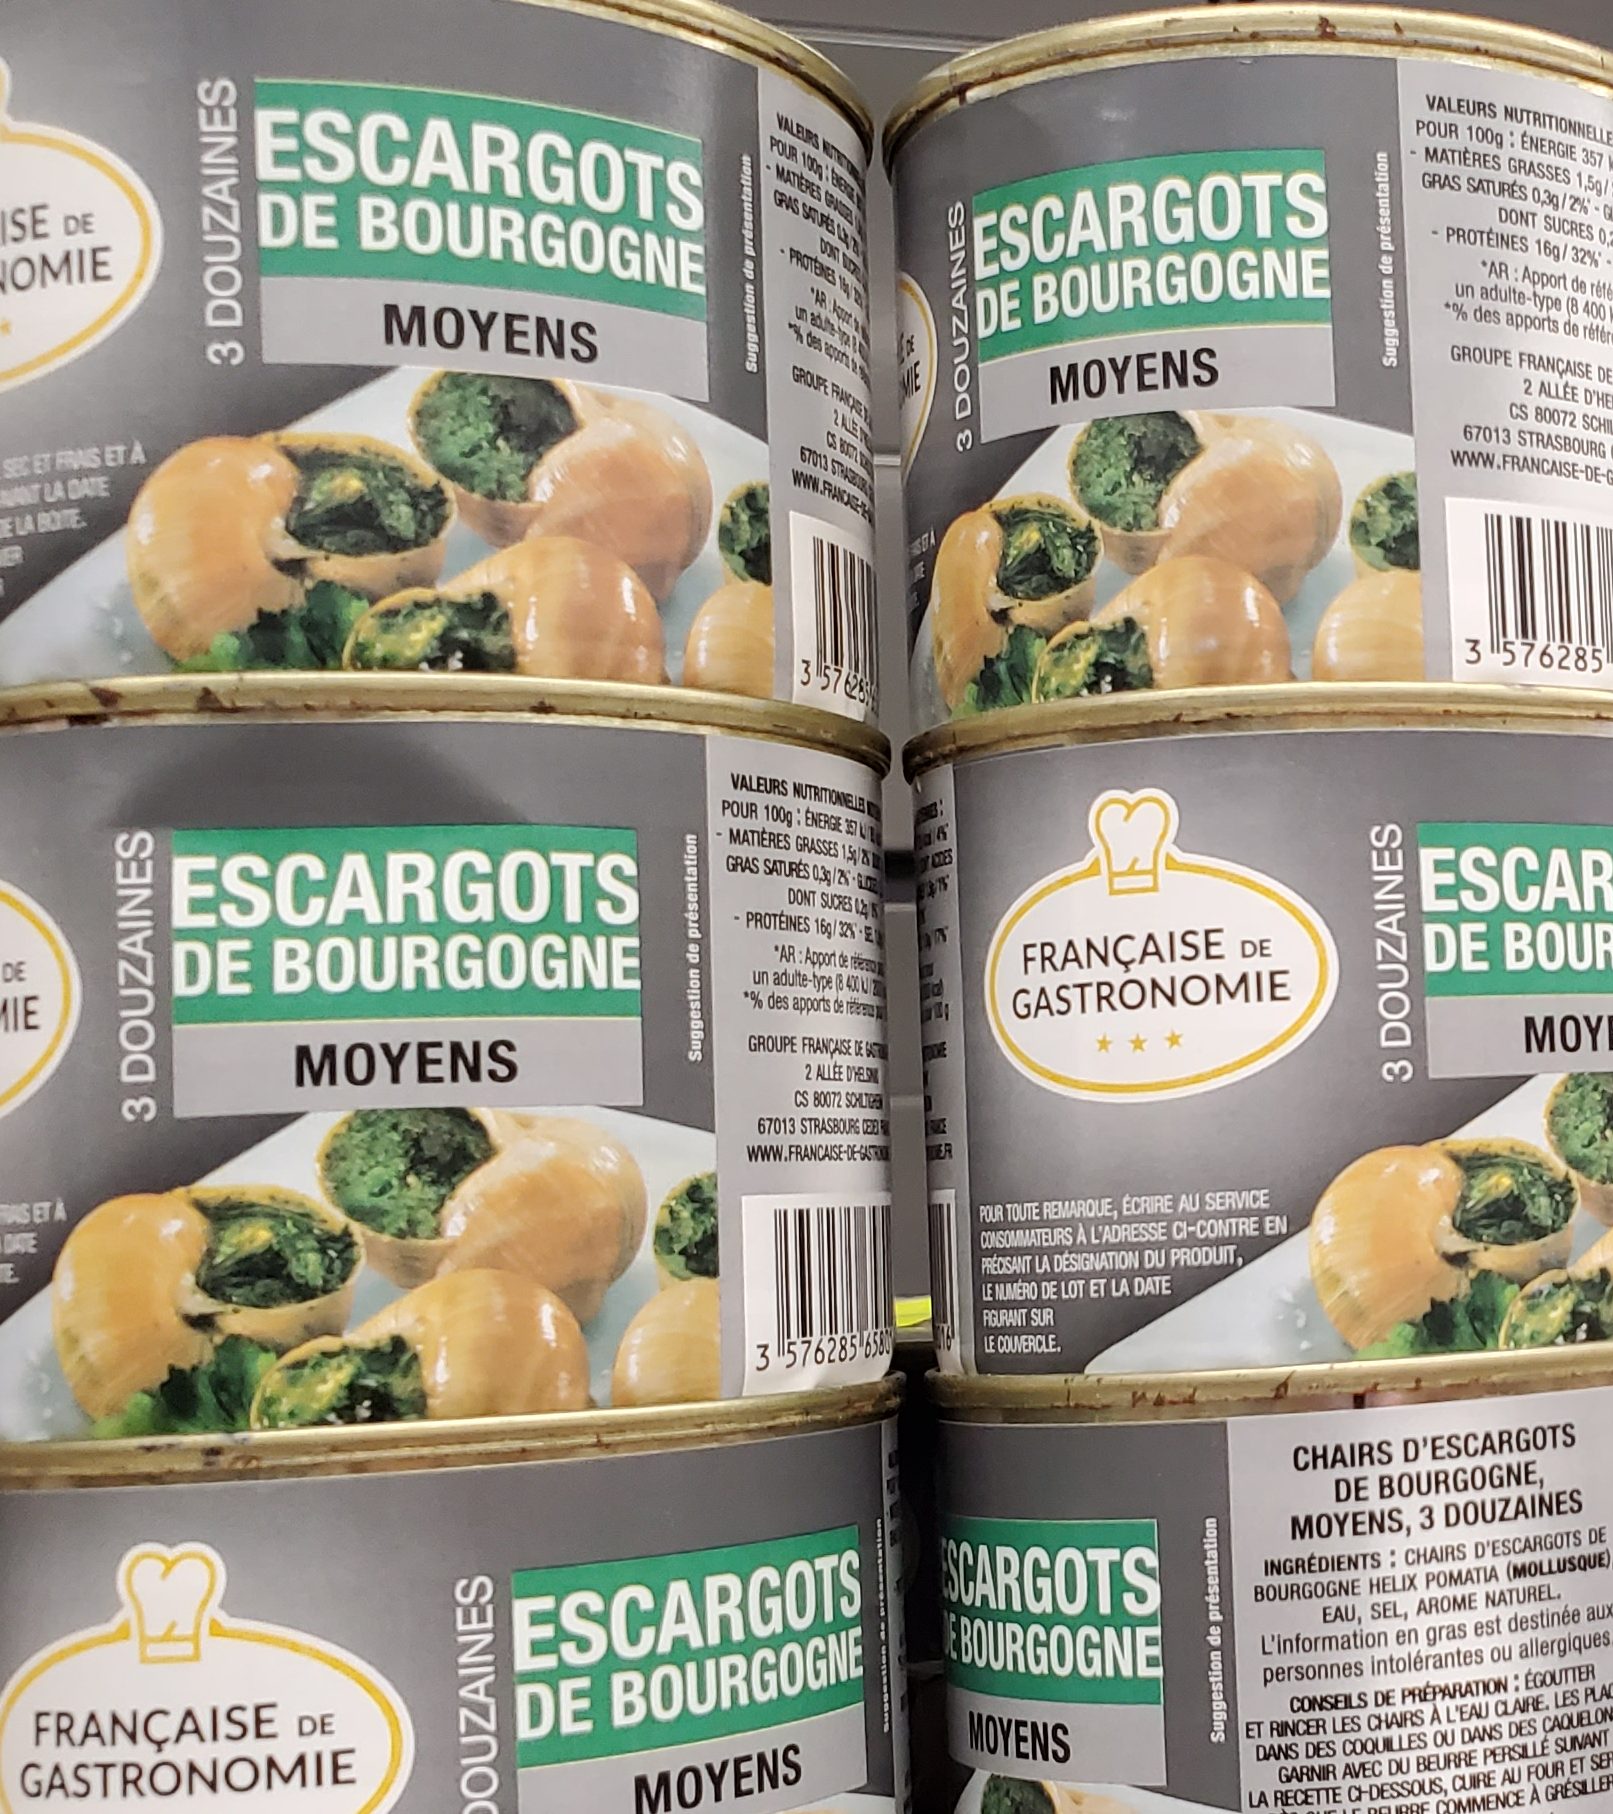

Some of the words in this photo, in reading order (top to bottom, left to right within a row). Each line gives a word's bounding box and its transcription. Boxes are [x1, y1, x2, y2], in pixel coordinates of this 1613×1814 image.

[254, 108, 703, 232] ESCARGOTS
[63, 213, 95, 236] DE
[197, 77, 244, 327] DOUZAINES
[741, 154, 755, 258] présentation
[973, 172, 1329, 280] ESCARGOTS
[1376, 152, 1394, 251] présentation
[256, 190, 339, 250] DE
[359, 194, 705, 294] BOURGOGNE
[1379, 255, 1393, 274] de
[742, 259, 755, 280] de
[976, 279, 1021, 339] DE
[1034, 248, 1330, 324] BOURGOGNE
[382, 303, 599, 362] MOYENS
[744, 283, 759, 373] Suggestion
[948, 201, 973, 421] DOUZAINES
[1380, 279, 1399, 367] Suggestion
[206, 341, 245, 366] 3
[1050, 348, 1219, 404] MOYENS
[1450, 344, 1512, 367] GROUPE
[1518, 351, 1592, 380] FRANÇAISE
[1597, 365, 1612, 384] DE
[1508, 402, 1528, 421] CS
[1534, 405, 1576, 428] 80072
[1522, 378, 1532, 395] 2
[1538, 380, 1579, 403] ALLÉE
[956, 432, 973, 451] 3
[1462, 424, 1511, 444] 67013
[1517, 429, 1606, 458] STRASBOURG
[1465, 639, 1481, 664] 3
[1502, 641, 1602, 673] 576285
[172, 851, 640, 930] ESCARGOTS
[684, 834, 701, 938] présentation
[116, 830, 156, 1082] DOUZAINES
[686, 943, 699, 963] de
[1022, 928, 1225, 977] FRANÇAISE
[1240, 938, 1272, 959] DE
[1370, 823, 1411, 1044] DOUZAINES
[1425, 923, 1487, 973] DE
[174, 938, 251, 998] DE
[273, 935, 641, 994] BOURGOGNE
[687, 968, 704, 1062] Suggestion
[1012, 970, 1290, 1020] GASTRONOMIE
[294, 1039, 519, 1088] MOYENS
[1381, 1060, 1412, 1081] 3
[121, 1096, 156, 1122] 3
[979, 1204, 1004, 1222] POUR
[1005, 1201, 1040, 1222] TOUTE
[1042, 1197, 1118, 1220] REMARQUE,
[1122, 1193, 1173, 1215] ÉCRIRE
[1177, 1192, 1199, 1212] AU
[1204, 1188, 1270, 1210] SERVICE
[756, 1344, 769, 1371] 3
[786, 1334, 857, 1368] 576285
[1293, 1440, 1392, 1471] CHAIRS
[1403, 1423, 1576, 1462] D'ESCARGOTS
[1334, 1476, 1368, 1502] DE
[1378, 1460, 1544, 1499] BOURGOGNE,
[1290, 1507, 1411, 1540] MOYENS,
[1419, 1505, 1434, 1530] 3
[1444, 1489, 1582, 1527] DOUZAINES
[1204, 1517, 1223, 1622] présentation
[1253, 1578, 1361, 1602] BOURGOGNE
[1369, 1573, 1418, 1594] HELIX
[1425, 1565, 1499, 1589] POMATIA
[515, 1549, 860, 1674] ESCARGOTS
[1322, 1603, 1361, 1625] EAU,
[1370, 1600, 1408, 1620] SEL,
[1416, 1592, 1477, 1616] AROME
[1485, 1585, 1561, 1608] NATUREL.
[961, 1614, 1163, 1678] BOURGOGNE
[1206, 1625, 1221, 1646] de
[517, 1680, 594, 1742] DE
[610, 1633, 864, 1728] BOURGOGNE
[1262, 1660, 1363, 1688] personnes
[1370, 1648, 1484, 1676] intolérantes
[1490, 1644, 1512, 1662] ou
[1208, 1650, 1227, 1743] Suggestion
[34, 1703, 278, 1753] FRANÇAISE
[298, 1712, 335, 1735] DE
[970, 1711, 1071, 1763] MOYENS
[20, 1749, 356, 1800] GASTRONOMIE
[634, 1744, 802, 1814] MOYENS
